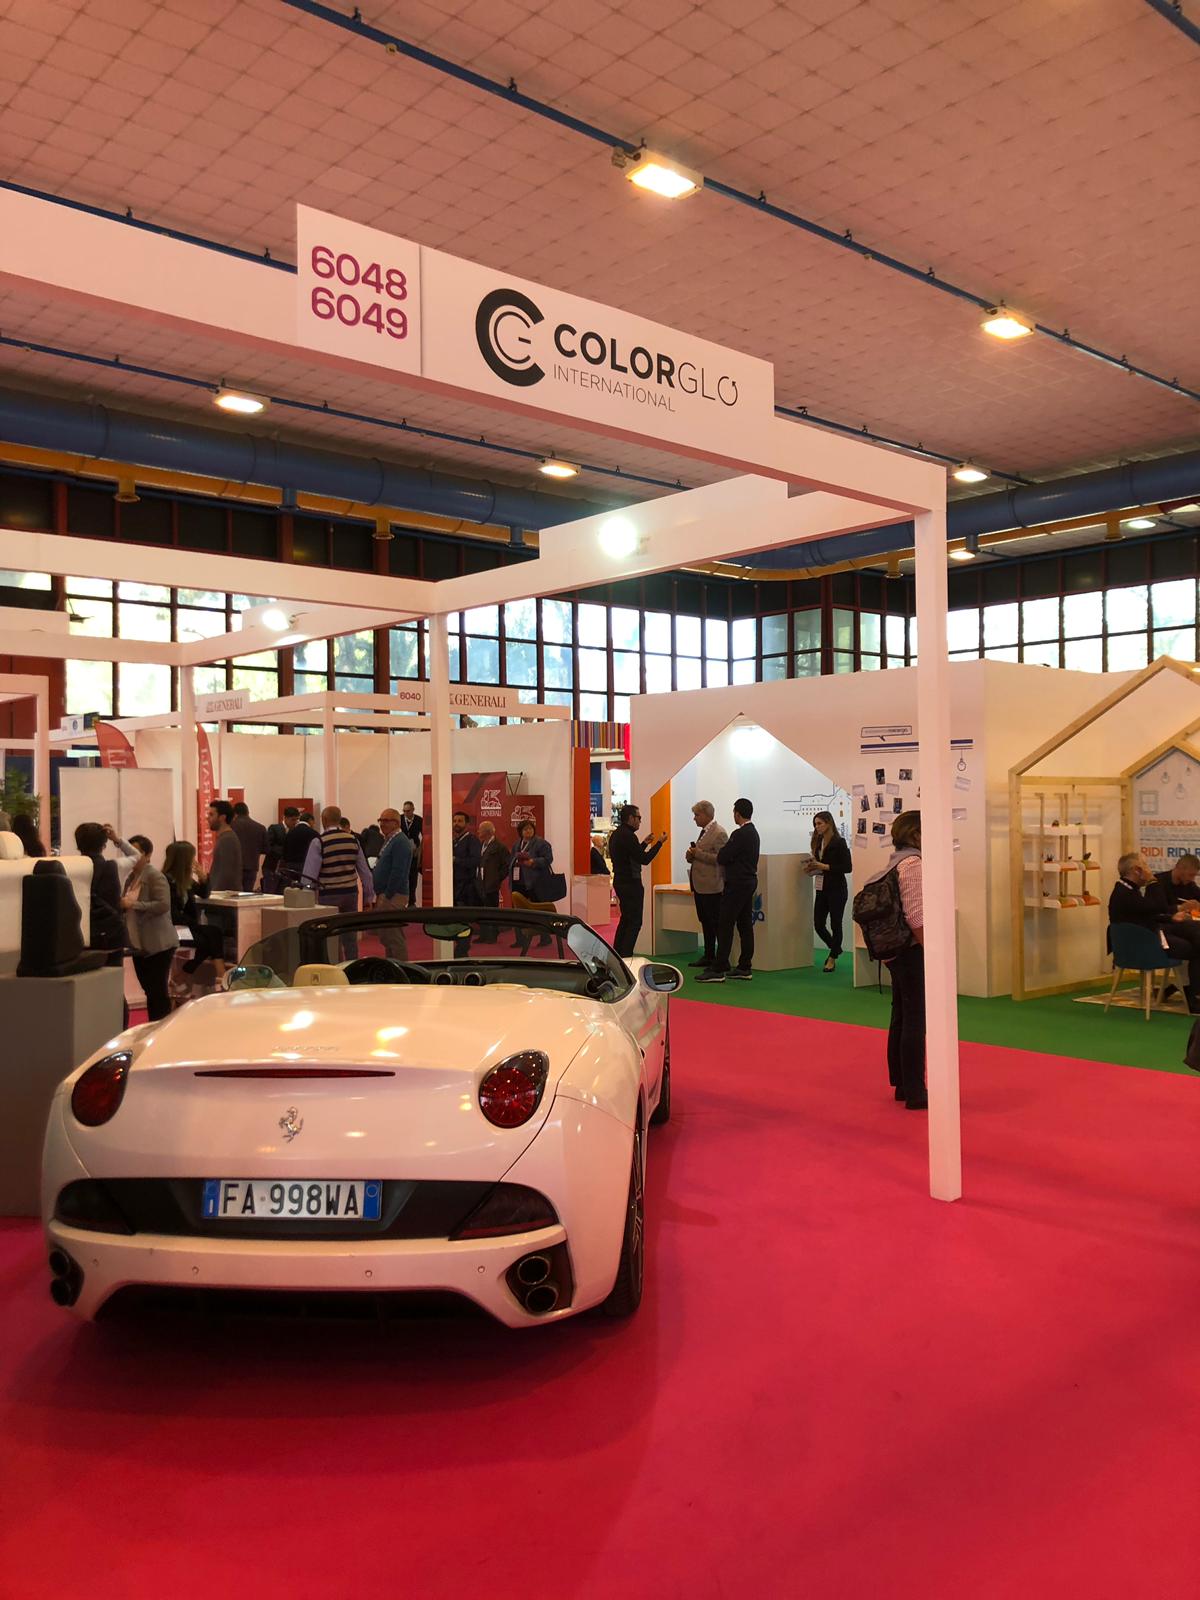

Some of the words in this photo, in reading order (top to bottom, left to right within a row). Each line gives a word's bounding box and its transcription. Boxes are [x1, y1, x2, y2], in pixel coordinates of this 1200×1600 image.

[311, 245, 408, 301] 6048
[311, 286, 408, 340] 6049
[553, 323, 739, 407] COLORGLO
[553, 364, 676, 413] INTERNATIONAL
[399, 691, 422, 701] 6040
[454, 693, 507, 708] GENERALI
[222, 1183, 256, 1214] FA
[269, 1183, 359, 1215] 998WA
